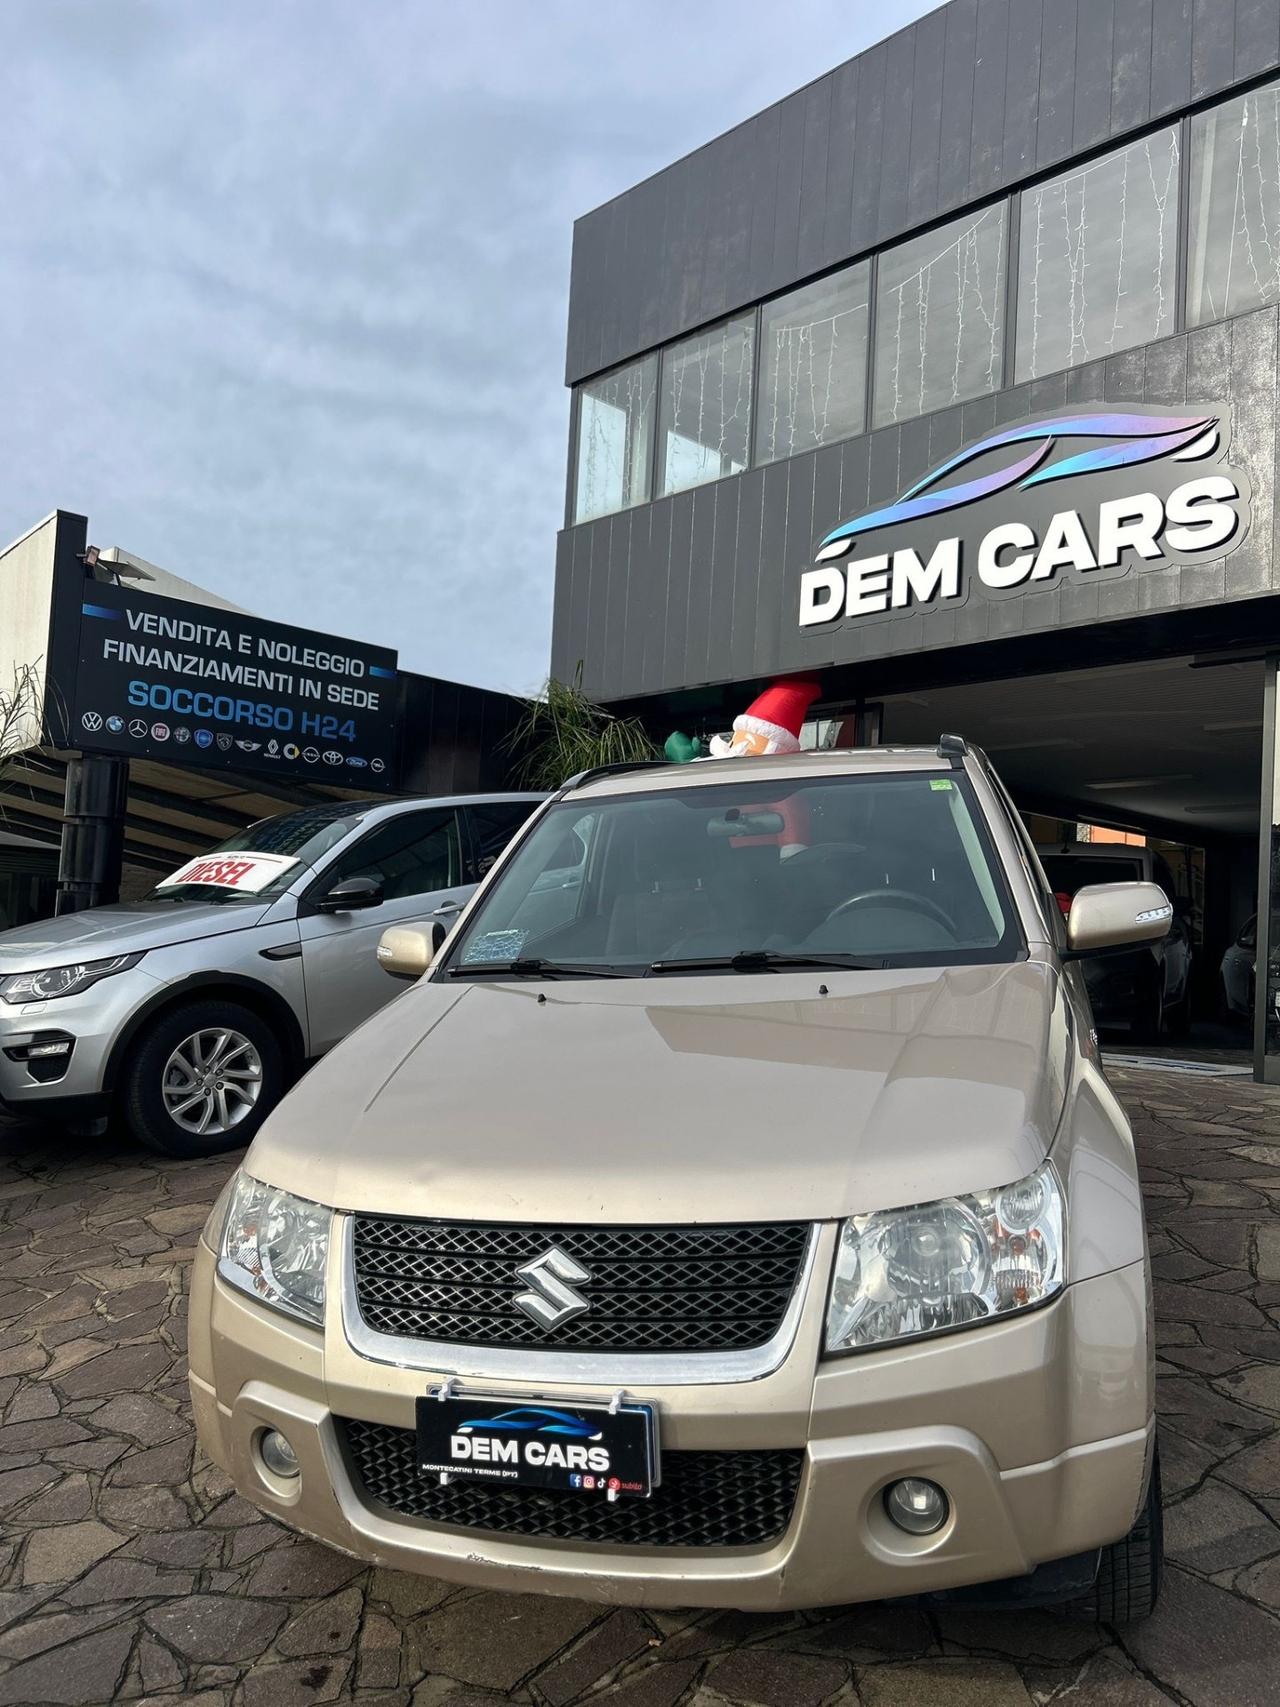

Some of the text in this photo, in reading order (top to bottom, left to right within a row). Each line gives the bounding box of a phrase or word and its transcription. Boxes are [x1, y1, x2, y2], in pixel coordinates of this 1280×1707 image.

[798, 476, 1239, 627] DEM CARS
[125, 608, 365, 678] VENDITA E NOLEGGIO
[103, 638, 380, 711] FINANZIAMENTI IN SEDE
[127, 680, 356, 742] SOCCORSO H24
[175, 860, 257, 886] DIESEL
[422, 1463, 473, 1474] MONTECATINI
[473, 1468, 502, 1477] TERME
[450, 1435, 610, 1472] DEM CARS
